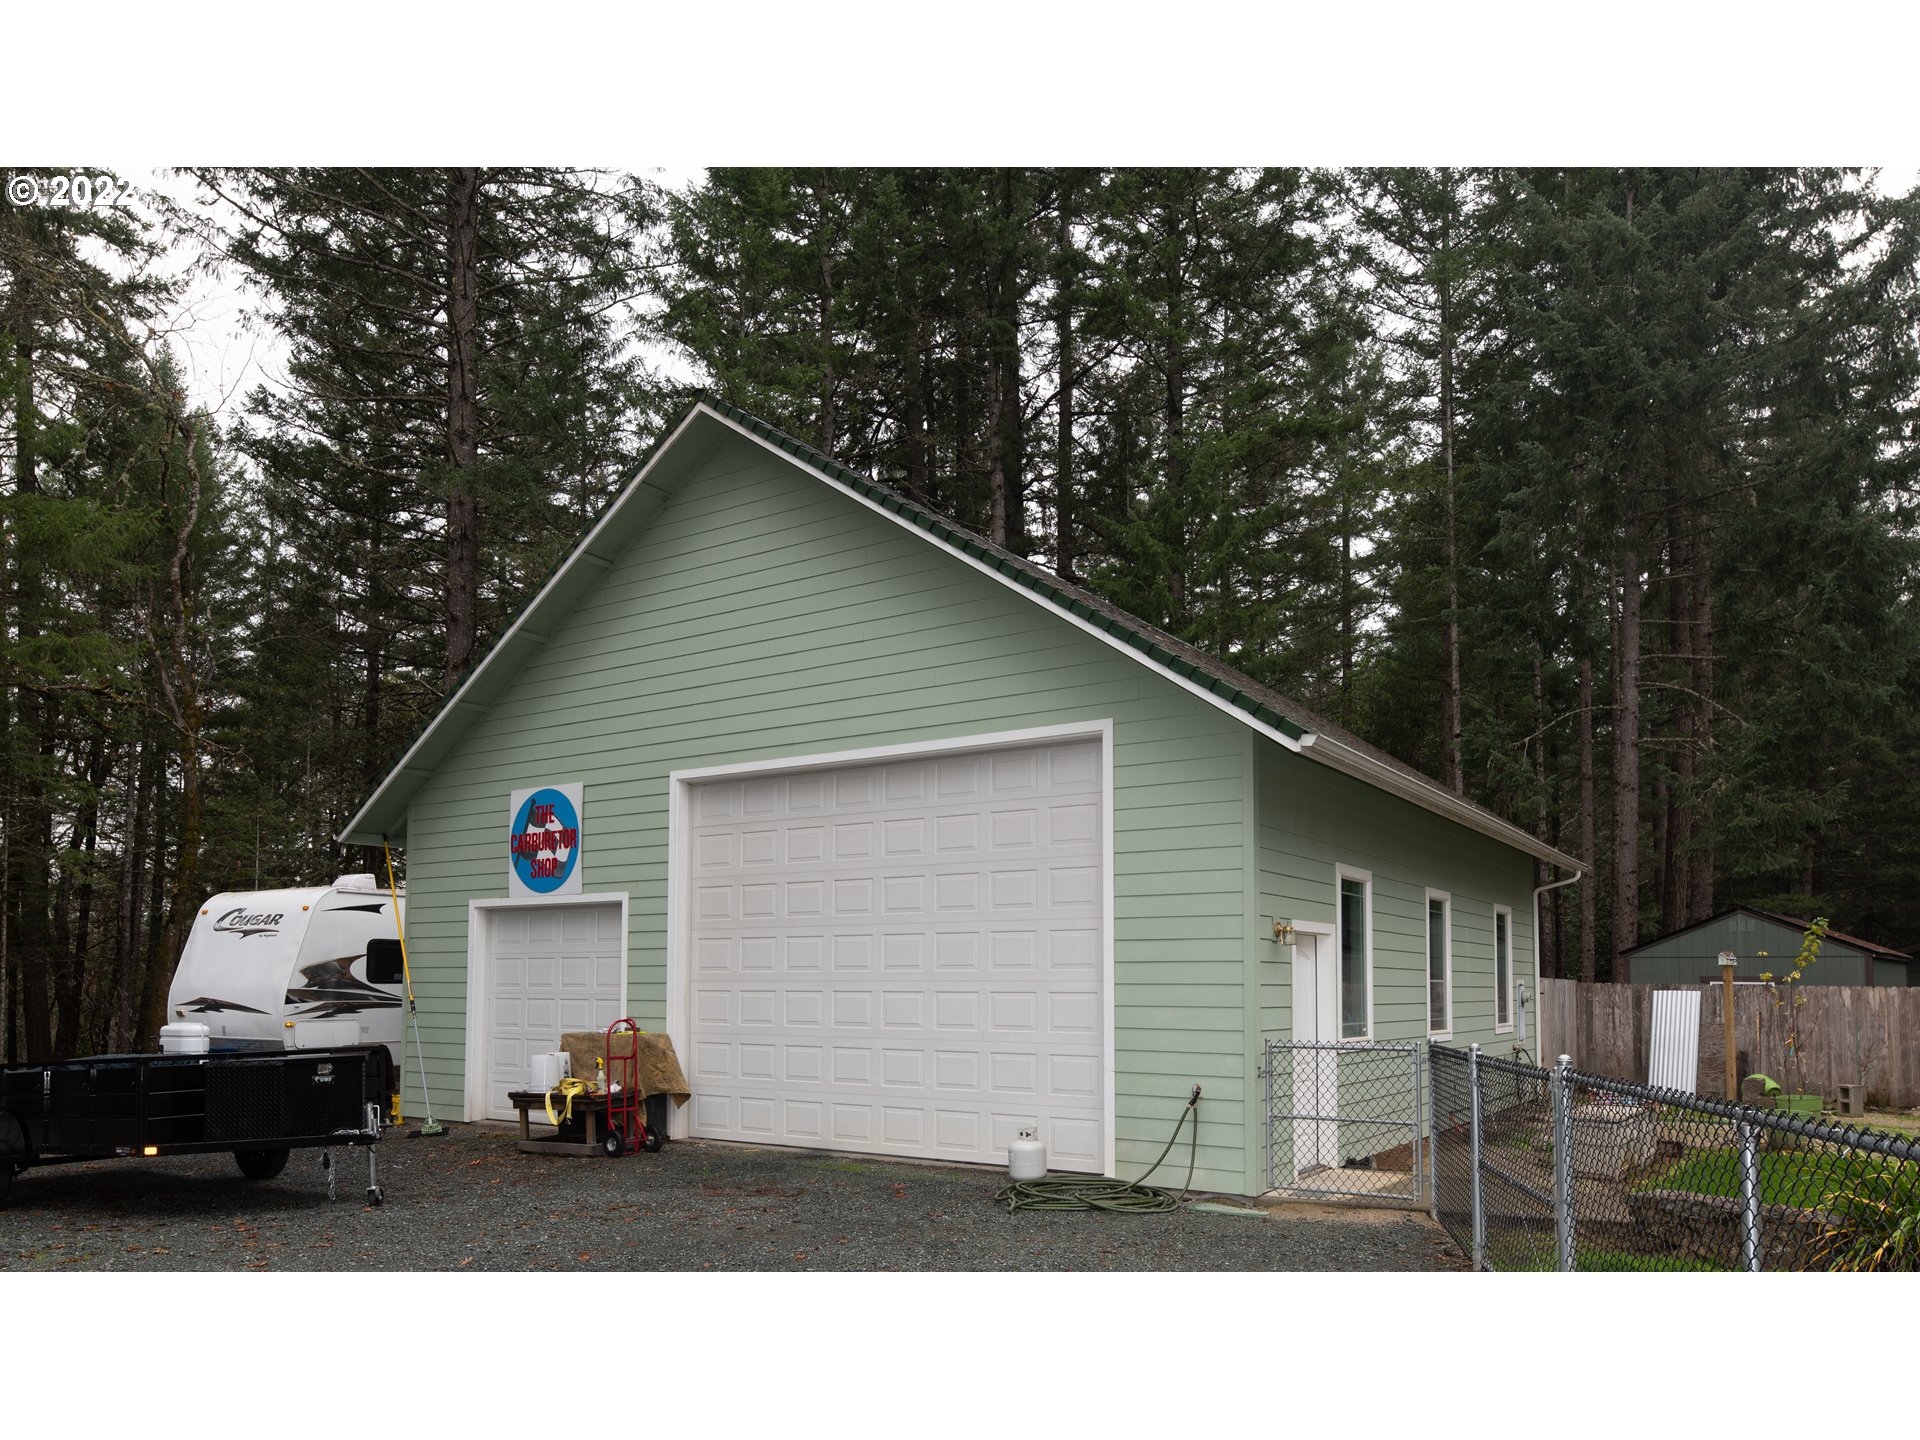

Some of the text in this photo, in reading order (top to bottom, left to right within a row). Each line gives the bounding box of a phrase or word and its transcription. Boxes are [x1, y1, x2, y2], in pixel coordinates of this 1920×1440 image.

[535, 804, 555, 824] THE
[511, 828, 577, 853] CARBURETOR
[530, 857, 558, 879] SHOP
[213, 907, 284, 931] COUGAR
